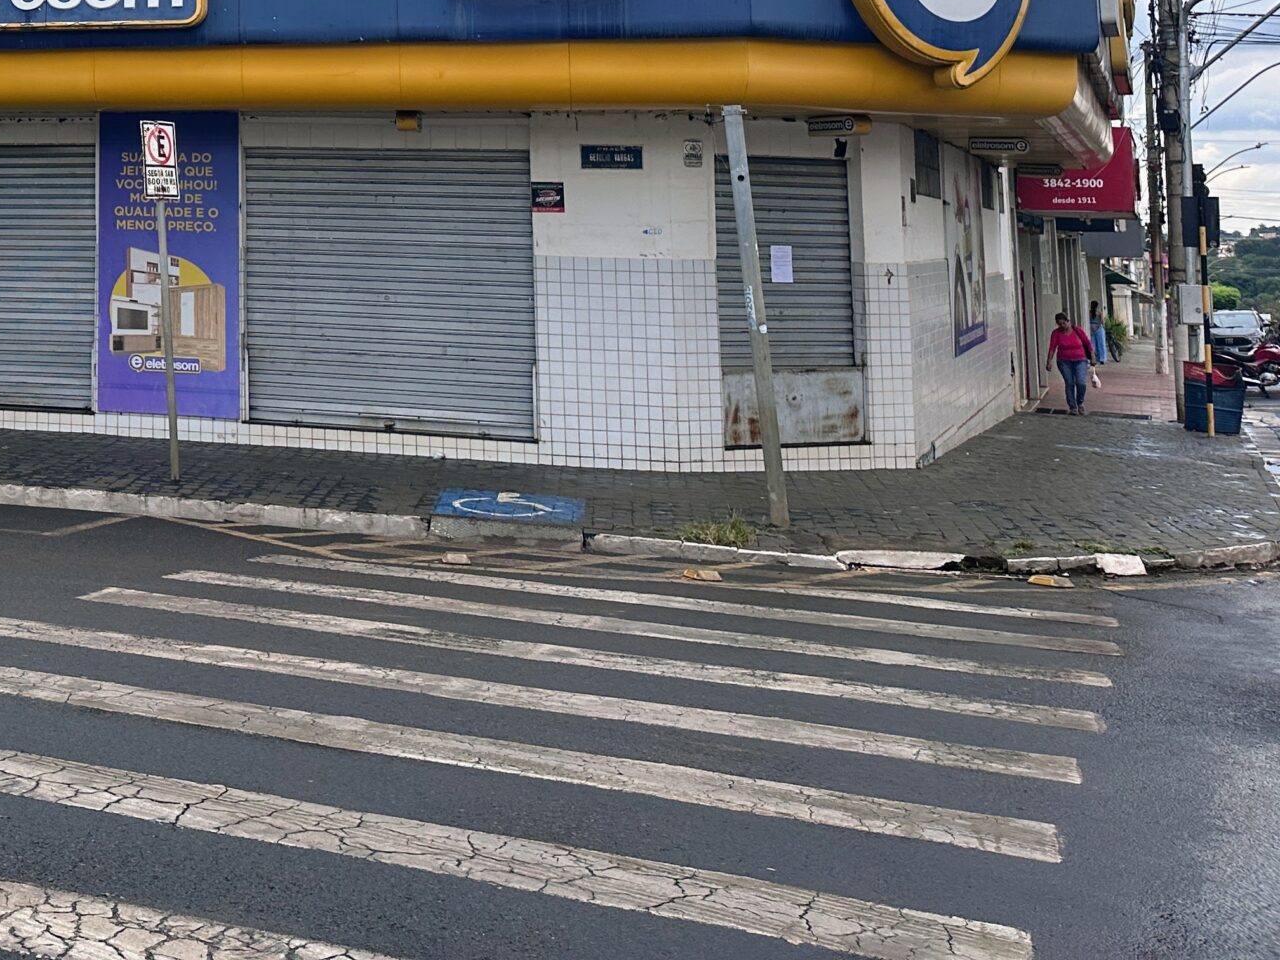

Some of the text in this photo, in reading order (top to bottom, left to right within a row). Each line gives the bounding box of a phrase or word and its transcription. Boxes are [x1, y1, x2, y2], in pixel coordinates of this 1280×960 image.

[192, 153, 212, 163] DO
[185, 166, 213, 177] QUE
[1042, 178, 1104, 188] 3842-1900
[184, 194, 203, 204] DE
[1052, 196, 1076, 204] desde
[114, 206, 219, 218] QUALIADE E O
[168, 221, 217, 233] PREÇO.
